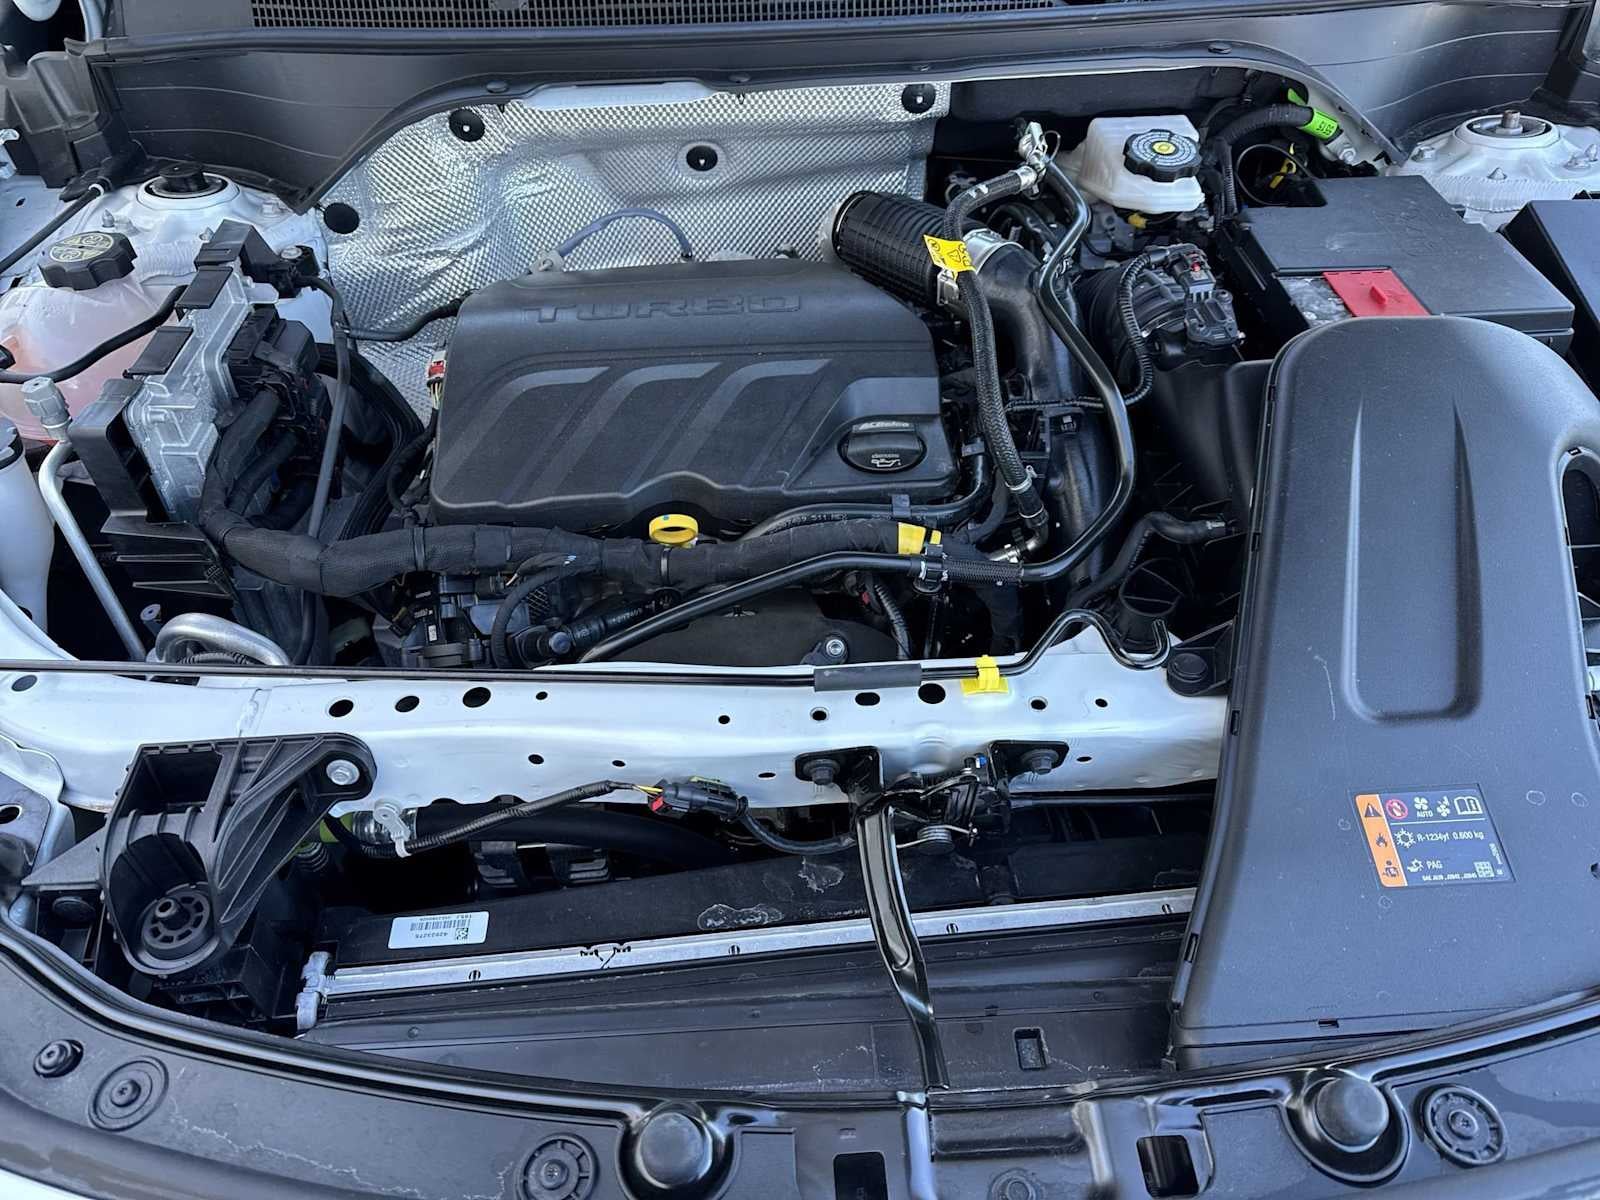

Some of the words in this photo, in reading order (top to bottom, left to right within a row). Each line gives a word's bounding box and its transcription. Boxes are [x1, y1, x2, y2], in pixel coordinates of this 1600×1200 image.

[521, 295, 801, 323] TURBO
[1416, 810, 1434, 818] AUTO
[1473, 829, 1485, 841] kg
[1426, 859, 1443, 870] PAG
